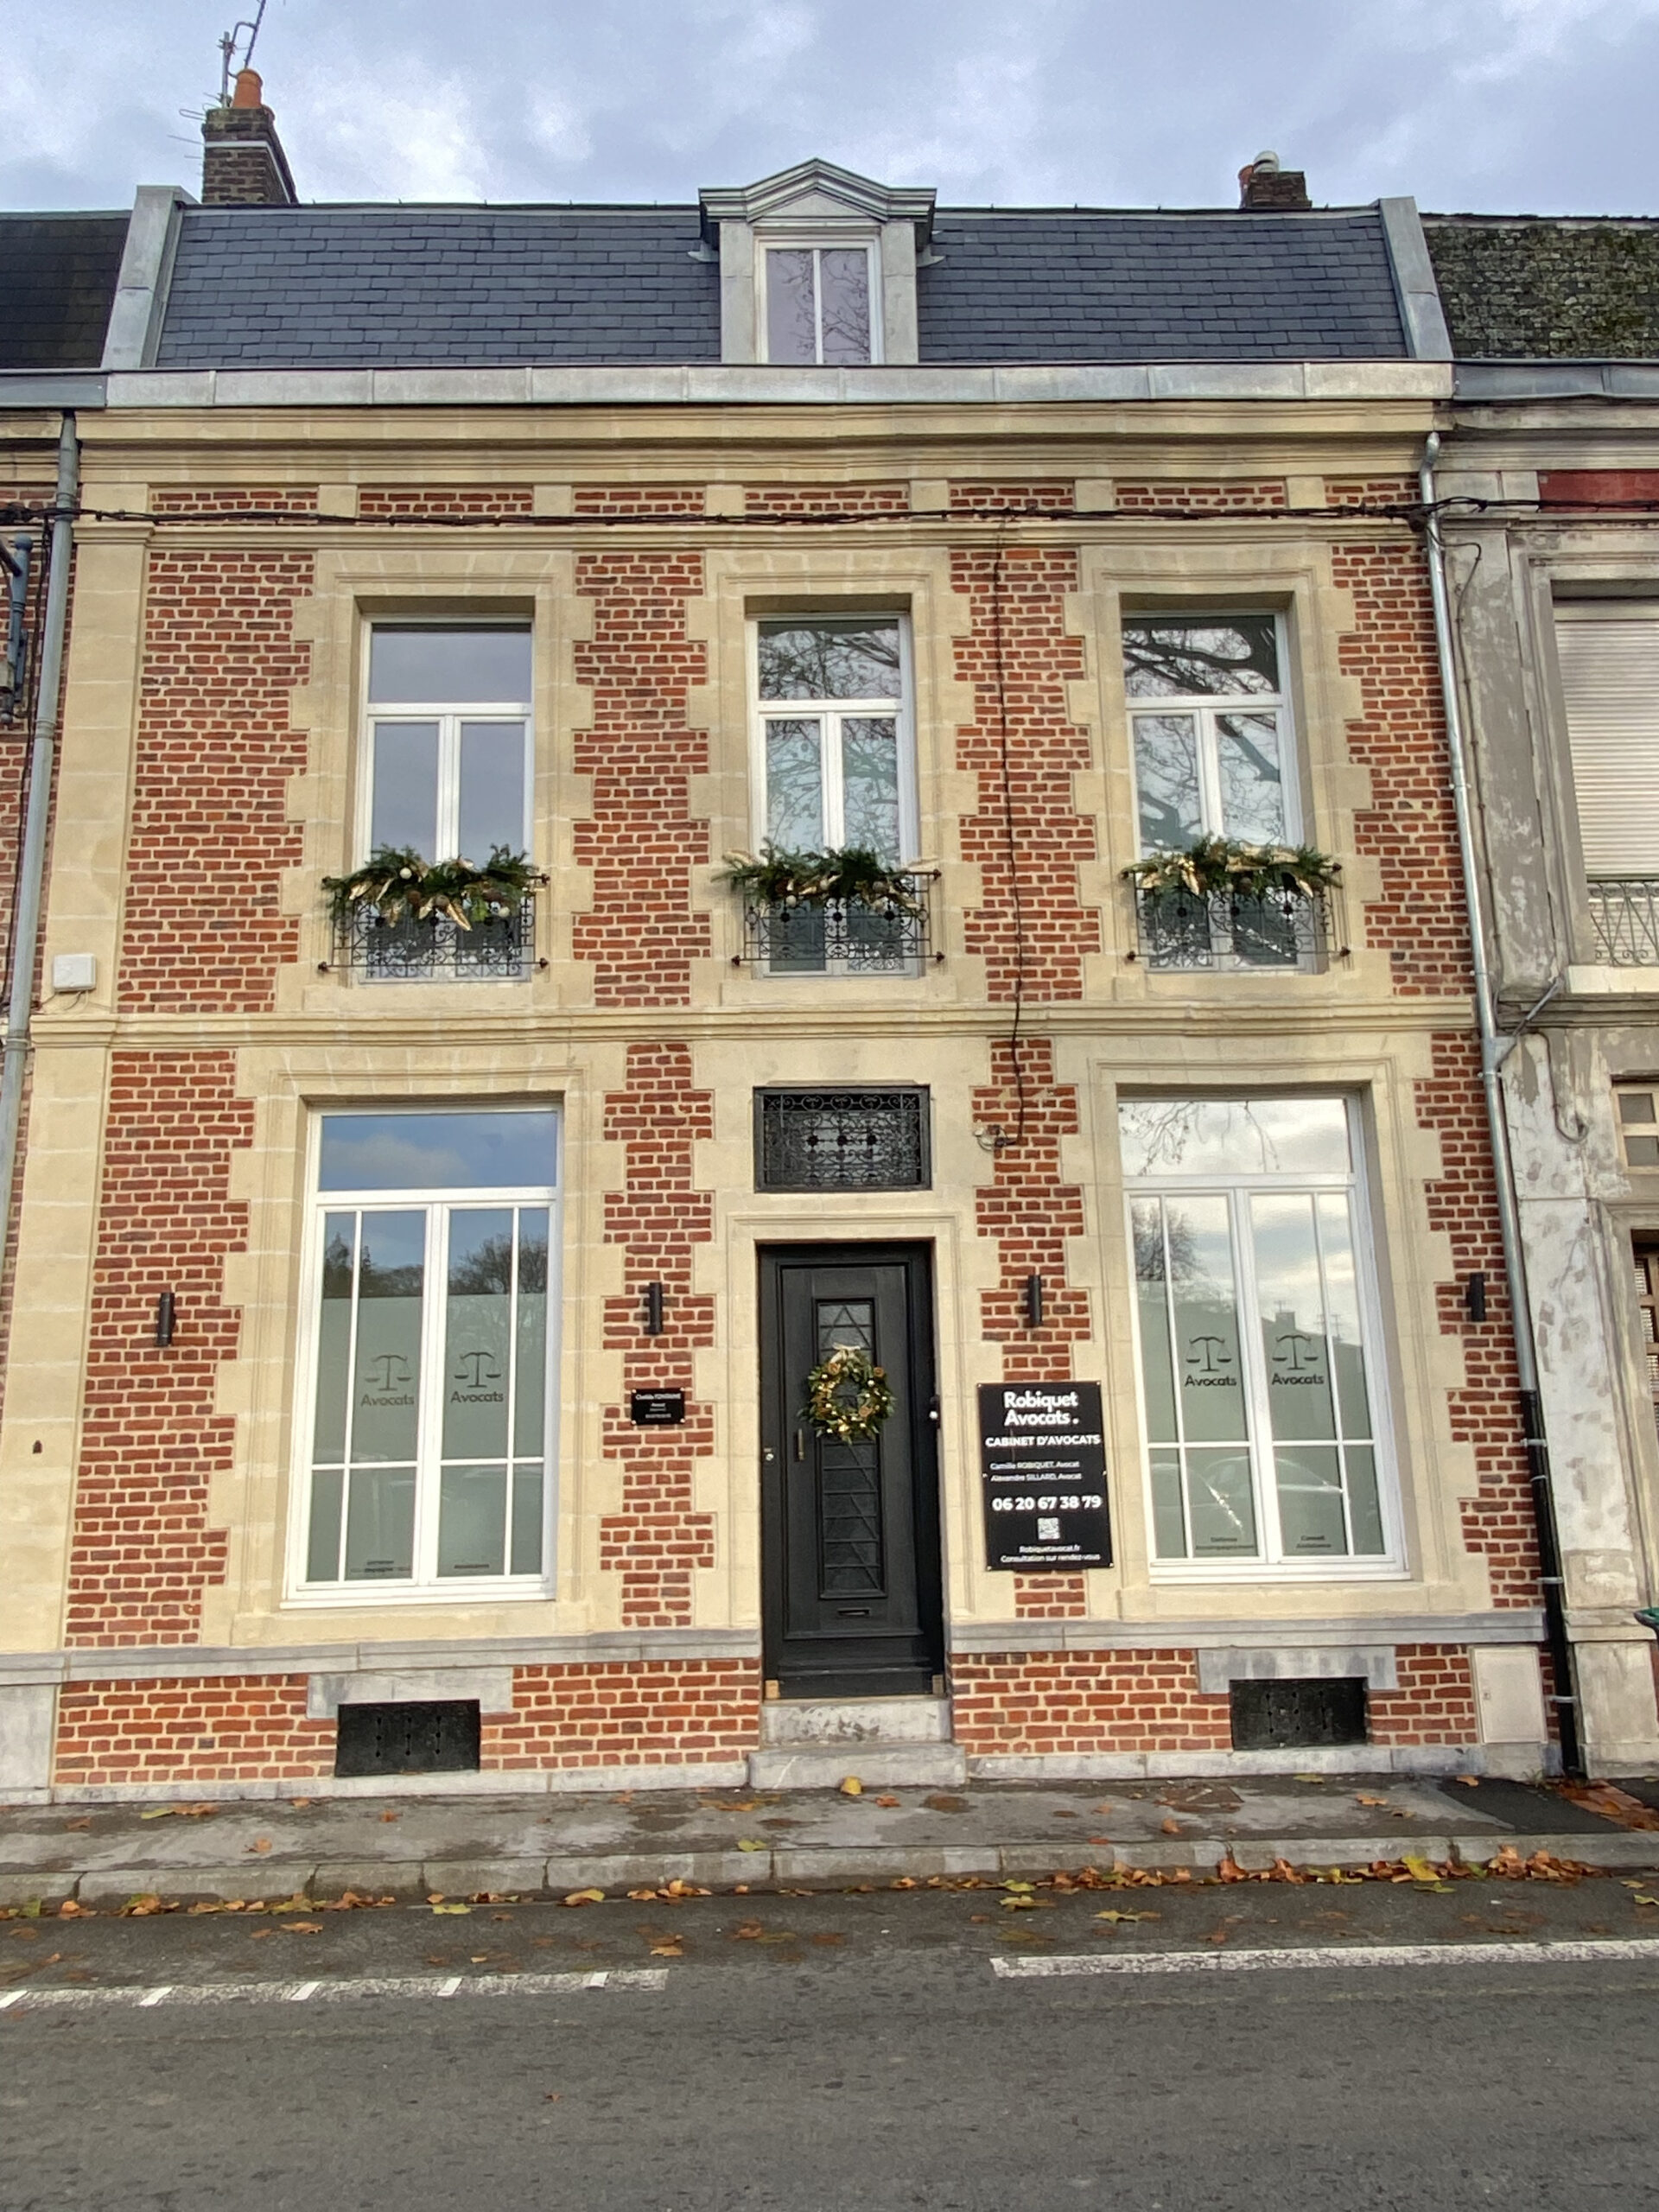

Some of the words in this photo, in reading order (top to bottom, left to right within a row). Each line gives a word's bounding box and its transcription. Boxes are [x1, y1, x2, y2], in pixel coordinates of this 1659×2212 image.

[1185, 1375, 1237, 1387] Avocats
[1271, 1373, 1325, 1385] Avocats
[360, 1394, 415, 1407] Avocats
[450, 1391, 504, 1403] Avocats
[1003, 1390, 1078, 1413] Robiquet
[985, 1436, 1035, 1447] CABINET
[1037, 1434, 1101, 1446] D'AVOCATS
[991, 1497, 1014, 1511] 06
[1015, 1497, 1035, 1510] 20
[1037, 1496, 1058, 1510] 67
[1059, 1495, 1080, 1509] 38
[1081, 1495, 1103, 1509] 79
